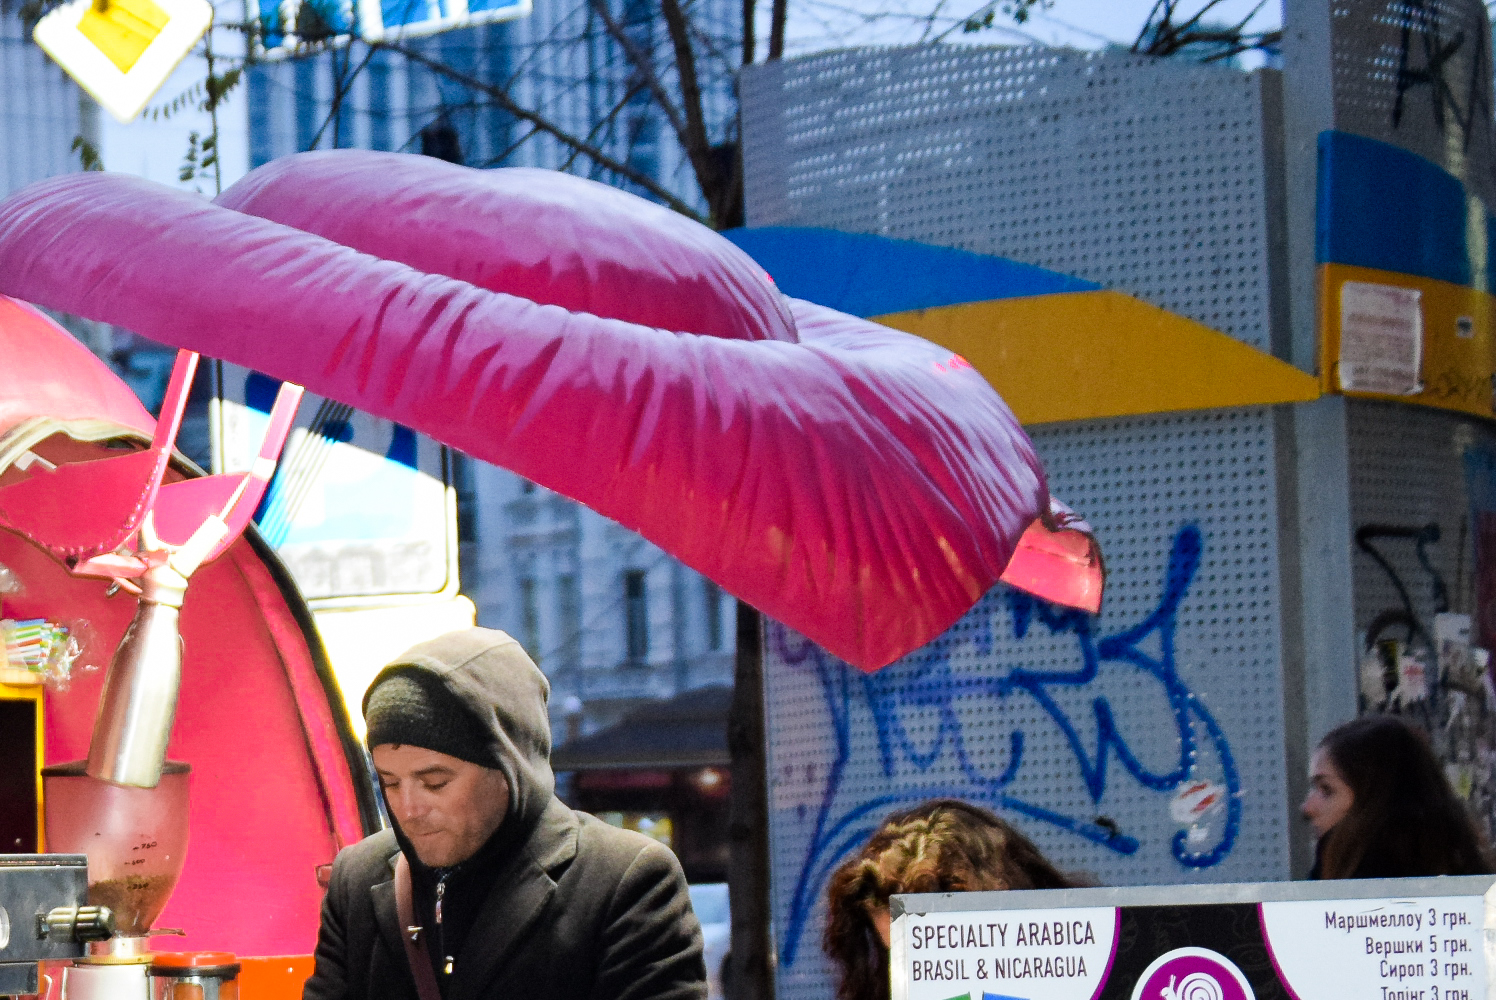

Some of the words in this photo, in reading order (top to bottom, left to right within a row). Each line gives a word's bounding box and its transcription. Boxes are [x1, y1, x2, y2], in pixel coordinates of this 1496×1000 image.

[1325, 911, 1422, 933] Маршмеллоу
[1428, 908, 1437, 926] 3
[1443, 912, 1472, 931] грн.
[912, 923, 1008, 949] SPECIALTY
[1016, 921, 1096, 946] ARABICA
[1365, 937, 1423, 958] Вершки
[1429, 935, 1437, 953] 5
[1443, 938, 1473, 957] грн.
[912, 959, 970, 981] BRASIL
[976, 958, 989, 980] &
[995, 956, 1088, 979] NICARAGUA
[1380, 960, 1424, 982] Сироп
[1430, 958, 1438, 977] 3
[1444, 963, 1473, 981] грн.
